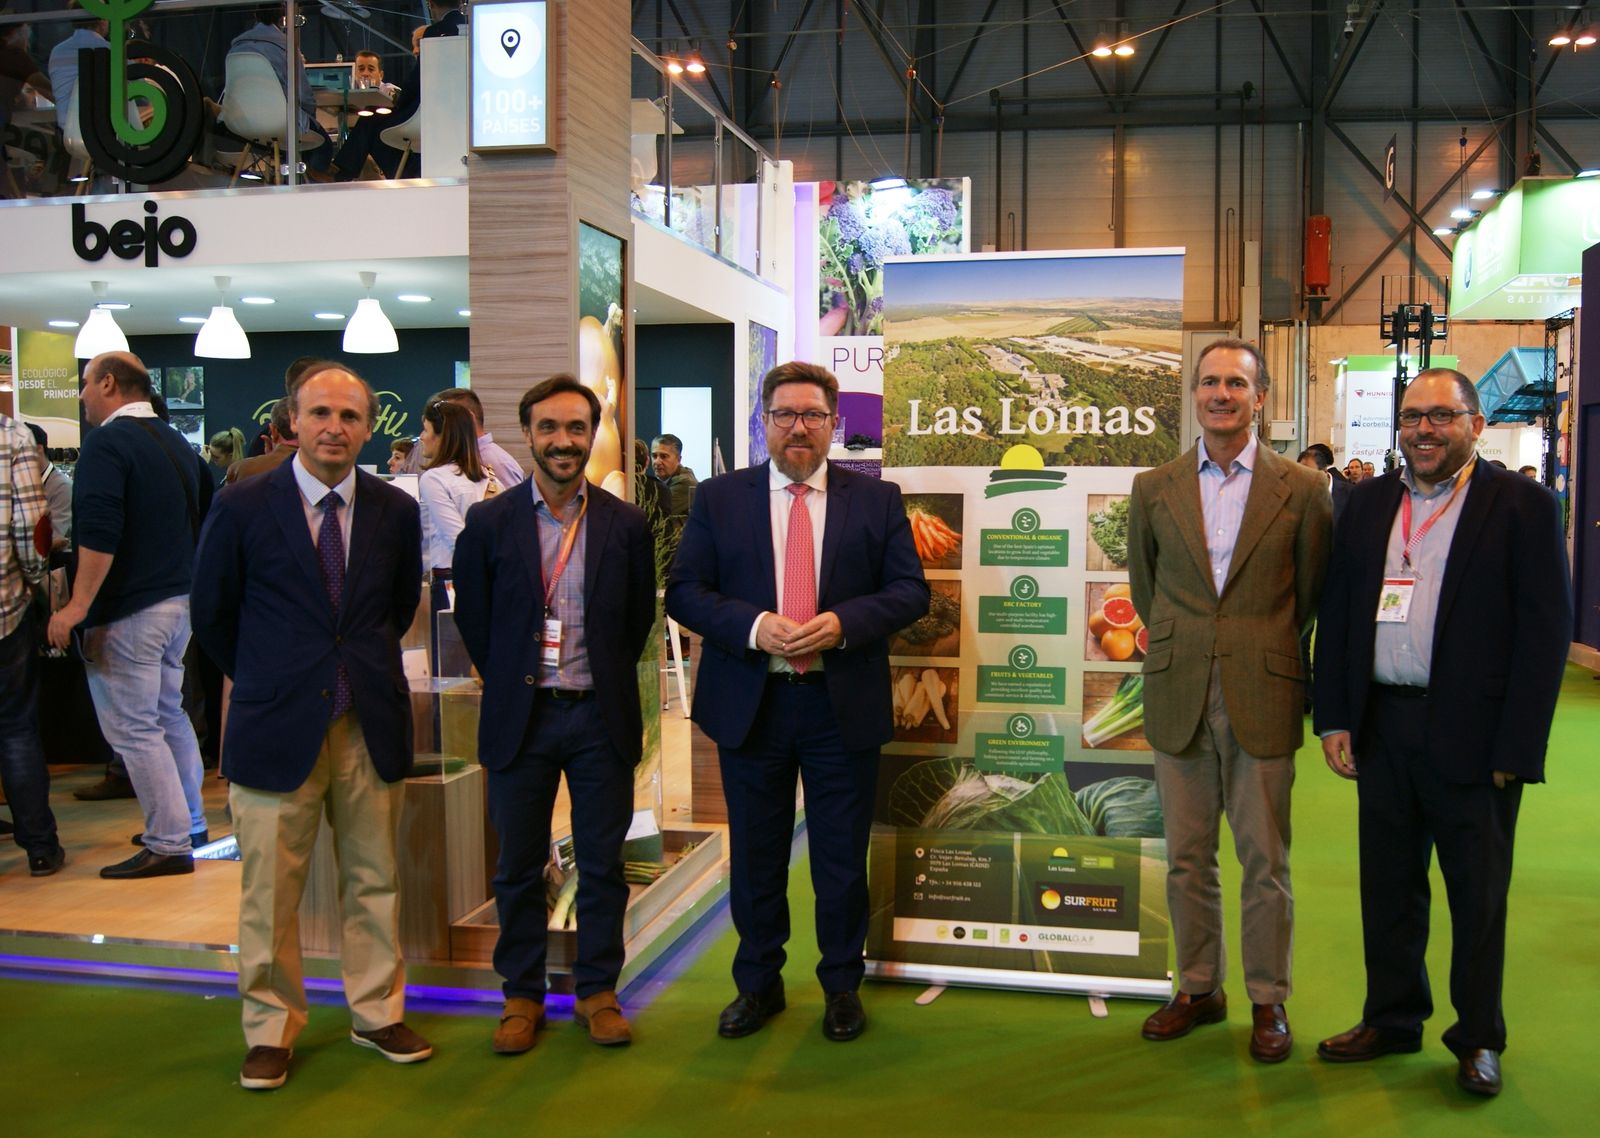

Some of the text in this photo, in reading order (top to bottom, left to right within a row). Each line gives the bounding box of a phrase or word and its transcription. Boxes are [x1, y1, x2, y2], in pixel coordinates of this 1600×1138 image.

[480, 88, 544, 114] 100+
[1386, 146, 1394, 189] G
[72, 200, 197, 268] bejo
[19, 380, 57, 389] DESDE EL
[907, 398, 1156, 436] Las Lomas
[1064, 896, 1118, 908] SURFRUIT
